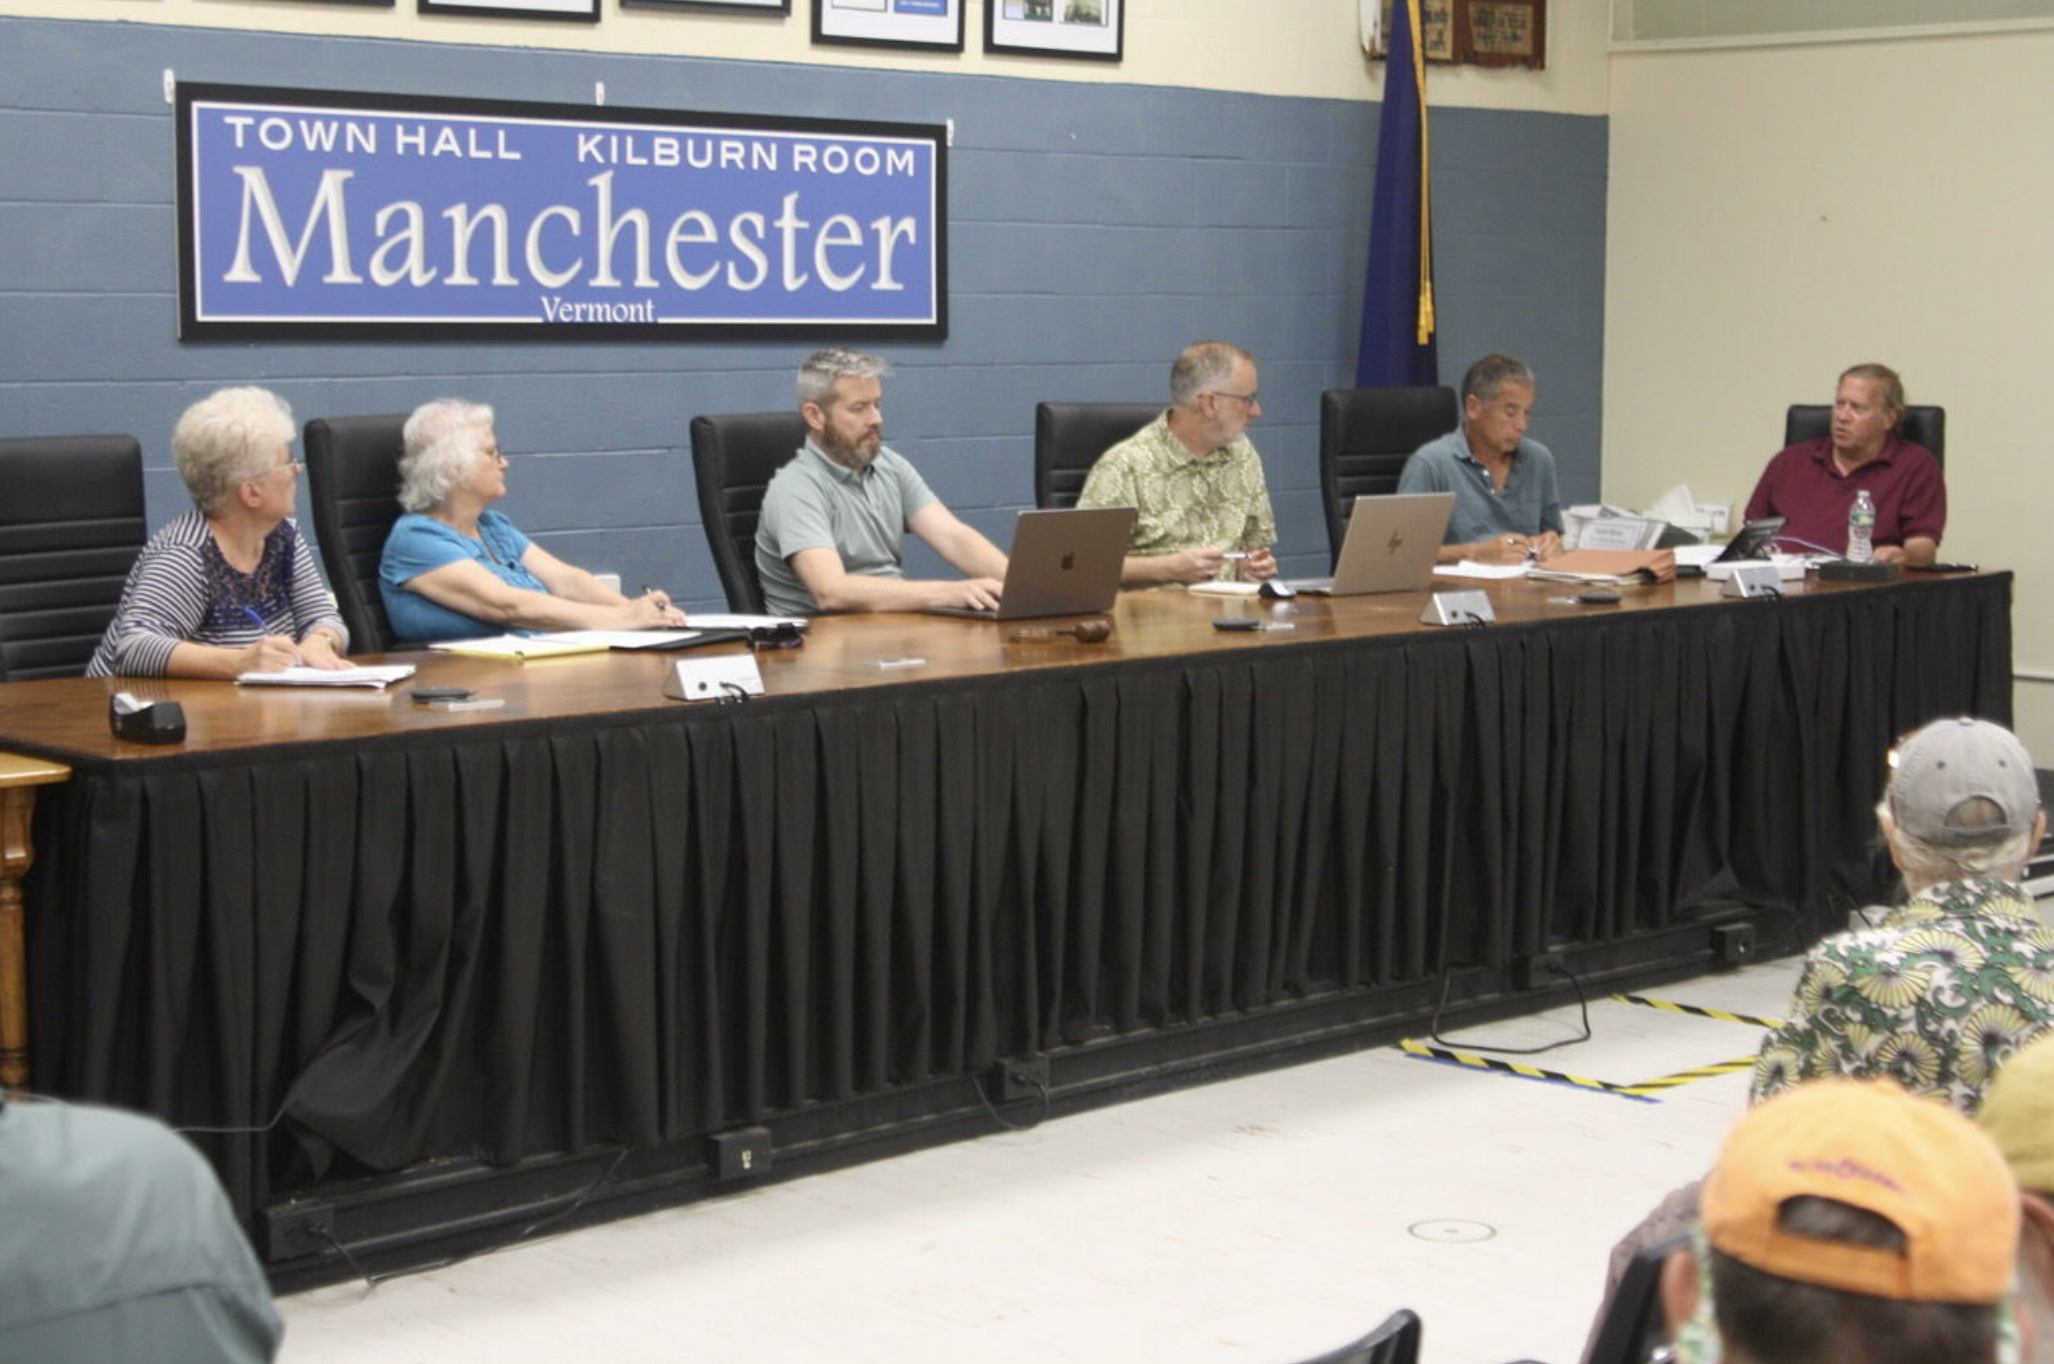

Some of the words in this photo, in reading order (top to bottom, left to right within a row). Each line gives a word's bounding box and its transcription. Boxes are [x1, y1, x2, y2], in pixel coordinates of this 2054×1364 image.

[223, 115, 377, 154] TOWN
[395, 124, 523, 160] HALL
[577, 134, 778, 170] KILBURN
[793, 143, 915, 177] ROOM
[222, 165, 916, 292] Manchester
[540, 296, 655, 323] Vermont
